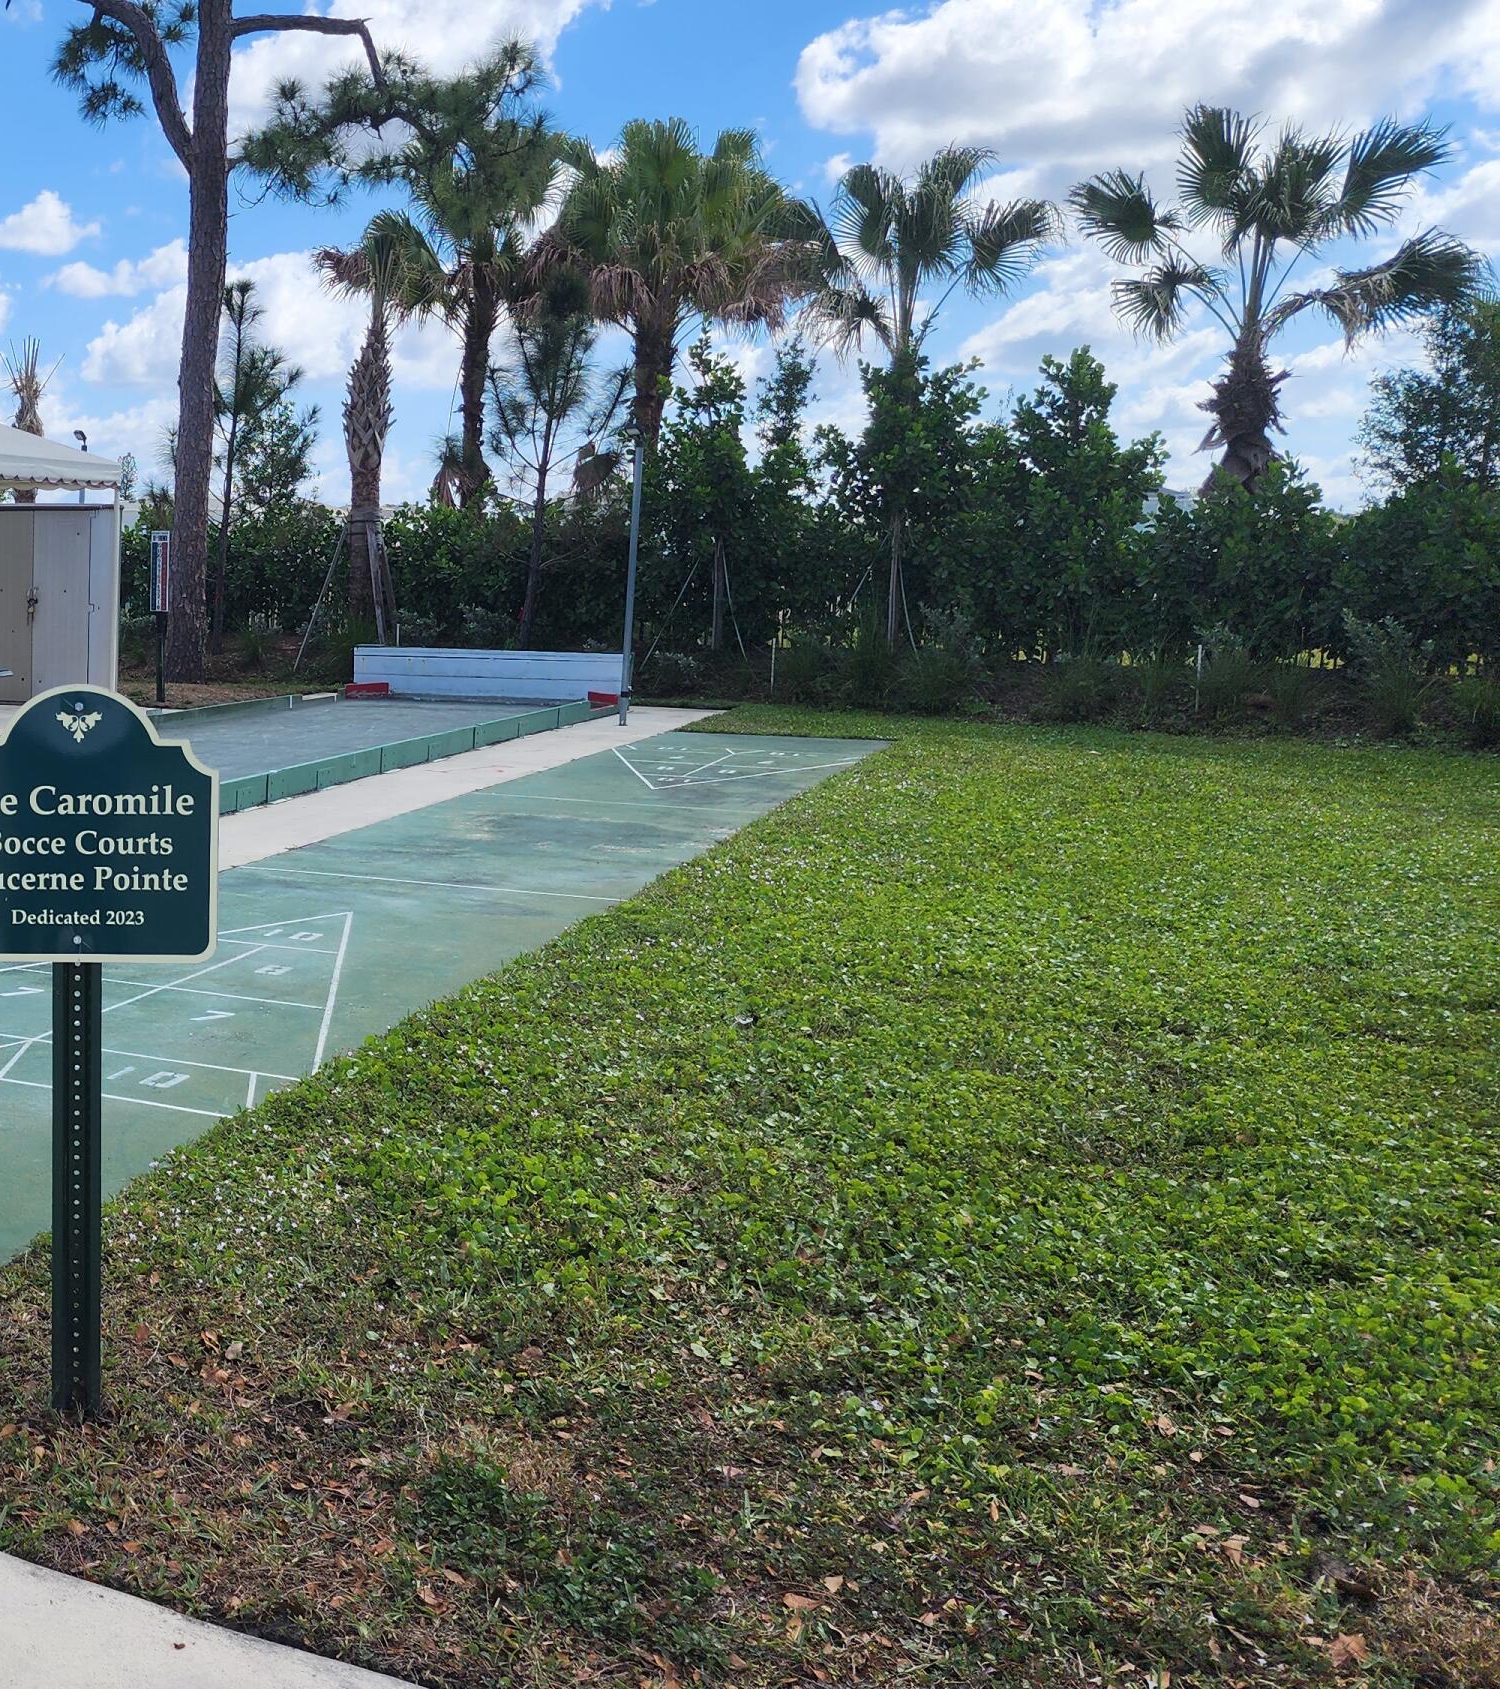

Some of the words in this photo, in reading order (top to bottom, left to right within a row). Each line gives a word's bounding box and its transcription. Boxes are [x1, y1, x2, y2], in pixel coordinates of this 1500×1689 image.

[29, 784, 195, 816] Caromile
[75, 830, 174, 856] Courts
[93, 866, 189, 892] Pointe
[11, 909, 100, 926] Dedicated
[106, 910, 145, 926] 2023
[189, 1010, 236, 1021] 7
